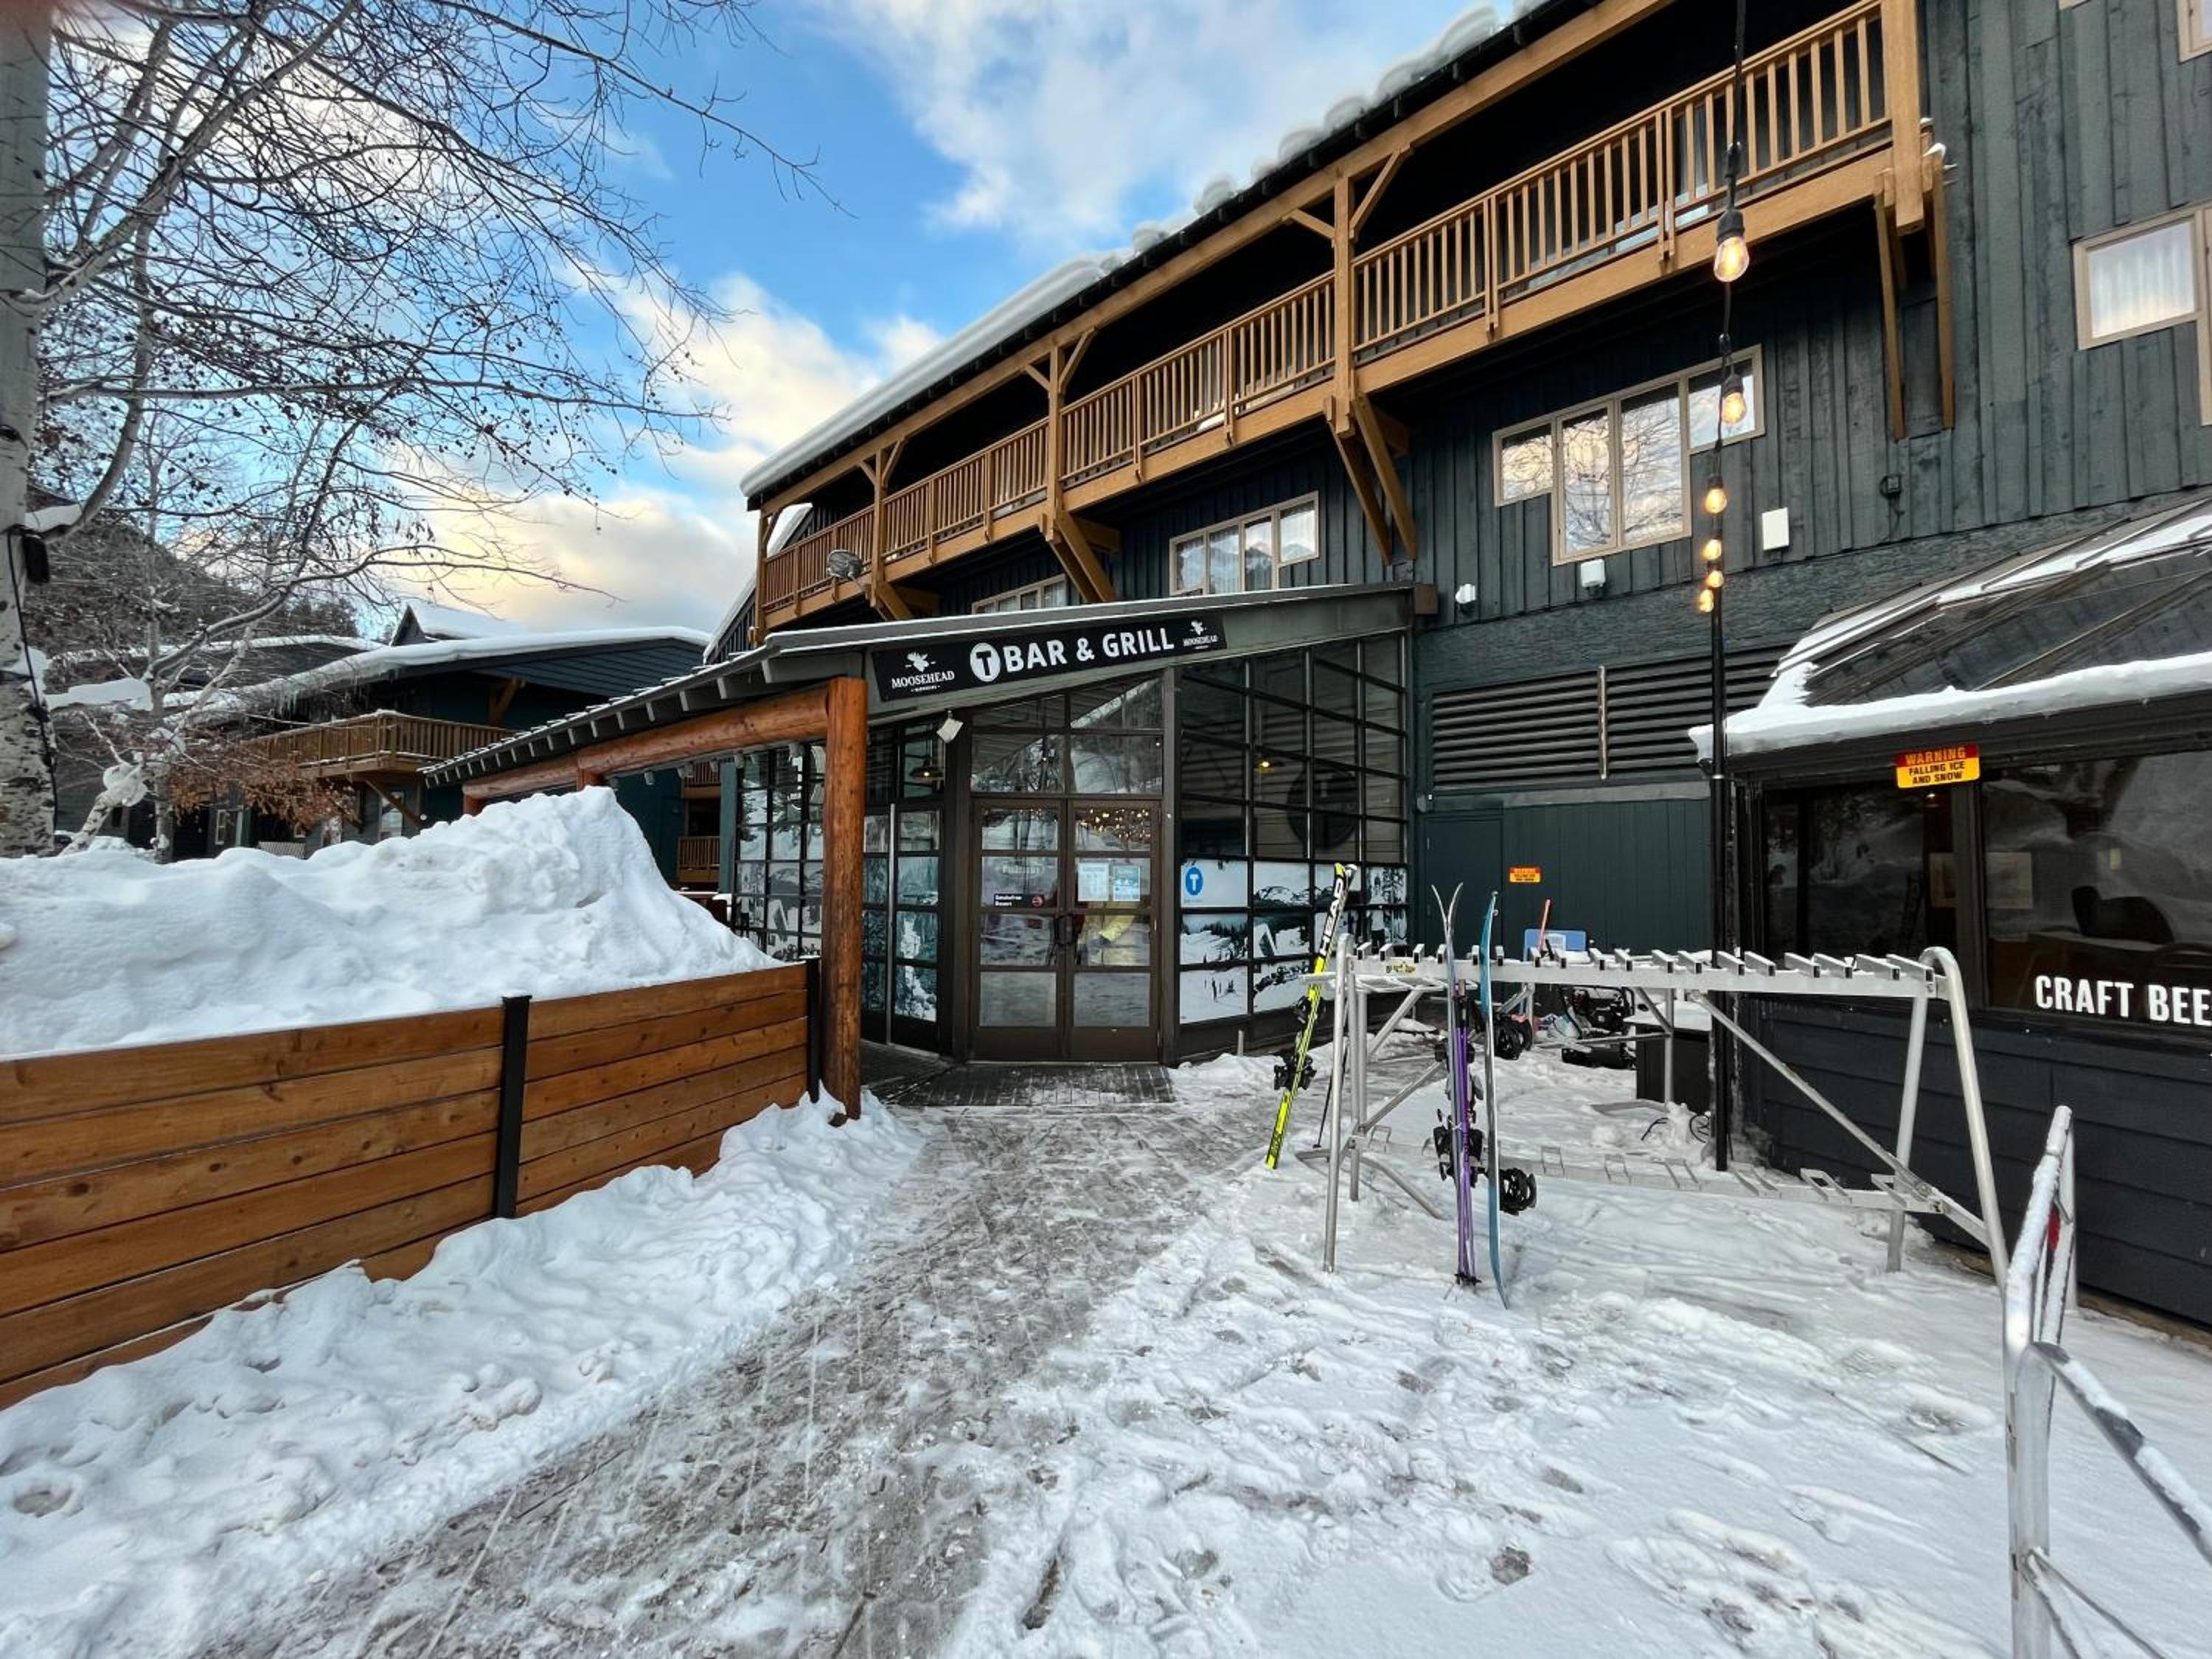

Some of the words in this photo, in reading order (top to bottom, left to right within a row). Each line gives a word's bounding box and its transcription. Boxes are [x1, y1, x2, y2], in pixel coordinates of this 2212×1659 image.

[1003, 639, 1068, 673] BAR
[1076, 637, 1096, 662] &
[1102, 627, 1175, 658] GRILL
[1183, 635, 1218, 647] MOOSEHEAD
[891, 670, 955, 689] MOOSEHEAD
[1905, 747, 1966, 766] WARNING
[1909, 763, 1946, 776] FALLING
[1949, 760, 1965, 771] ICE
[1912, 775, 1931, 785] AND
[1934, 771, 1963, 782] SNOW
[1319, 877, 1344, 956] HEAD
[2035, 975, 2135, 1019] CRAFT
